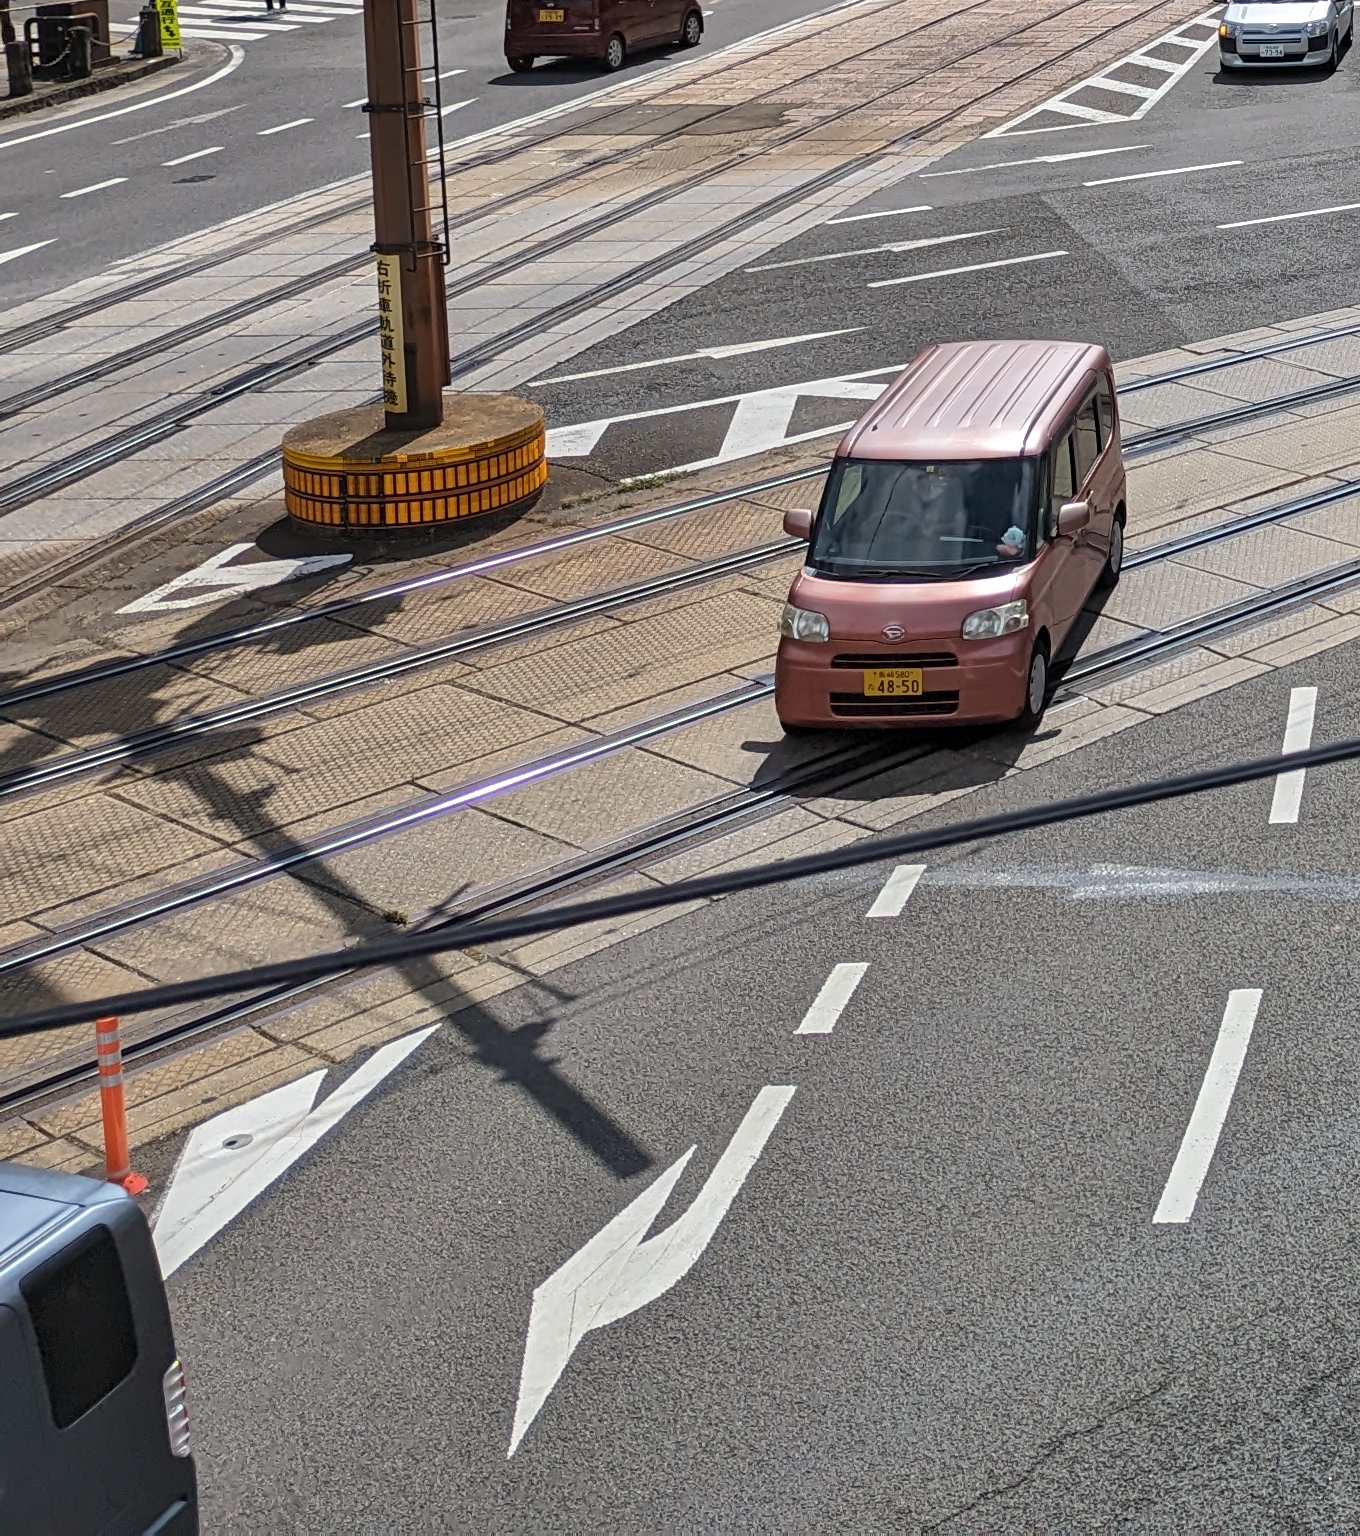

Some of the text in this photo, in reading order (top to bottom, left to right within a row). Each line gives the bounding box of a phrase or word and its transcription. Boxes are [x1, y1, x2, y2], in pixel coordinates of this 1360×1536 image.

[377, 259, 398, 406] 右折車軌道外待機
[876, 679, 920, 694] 48-50
